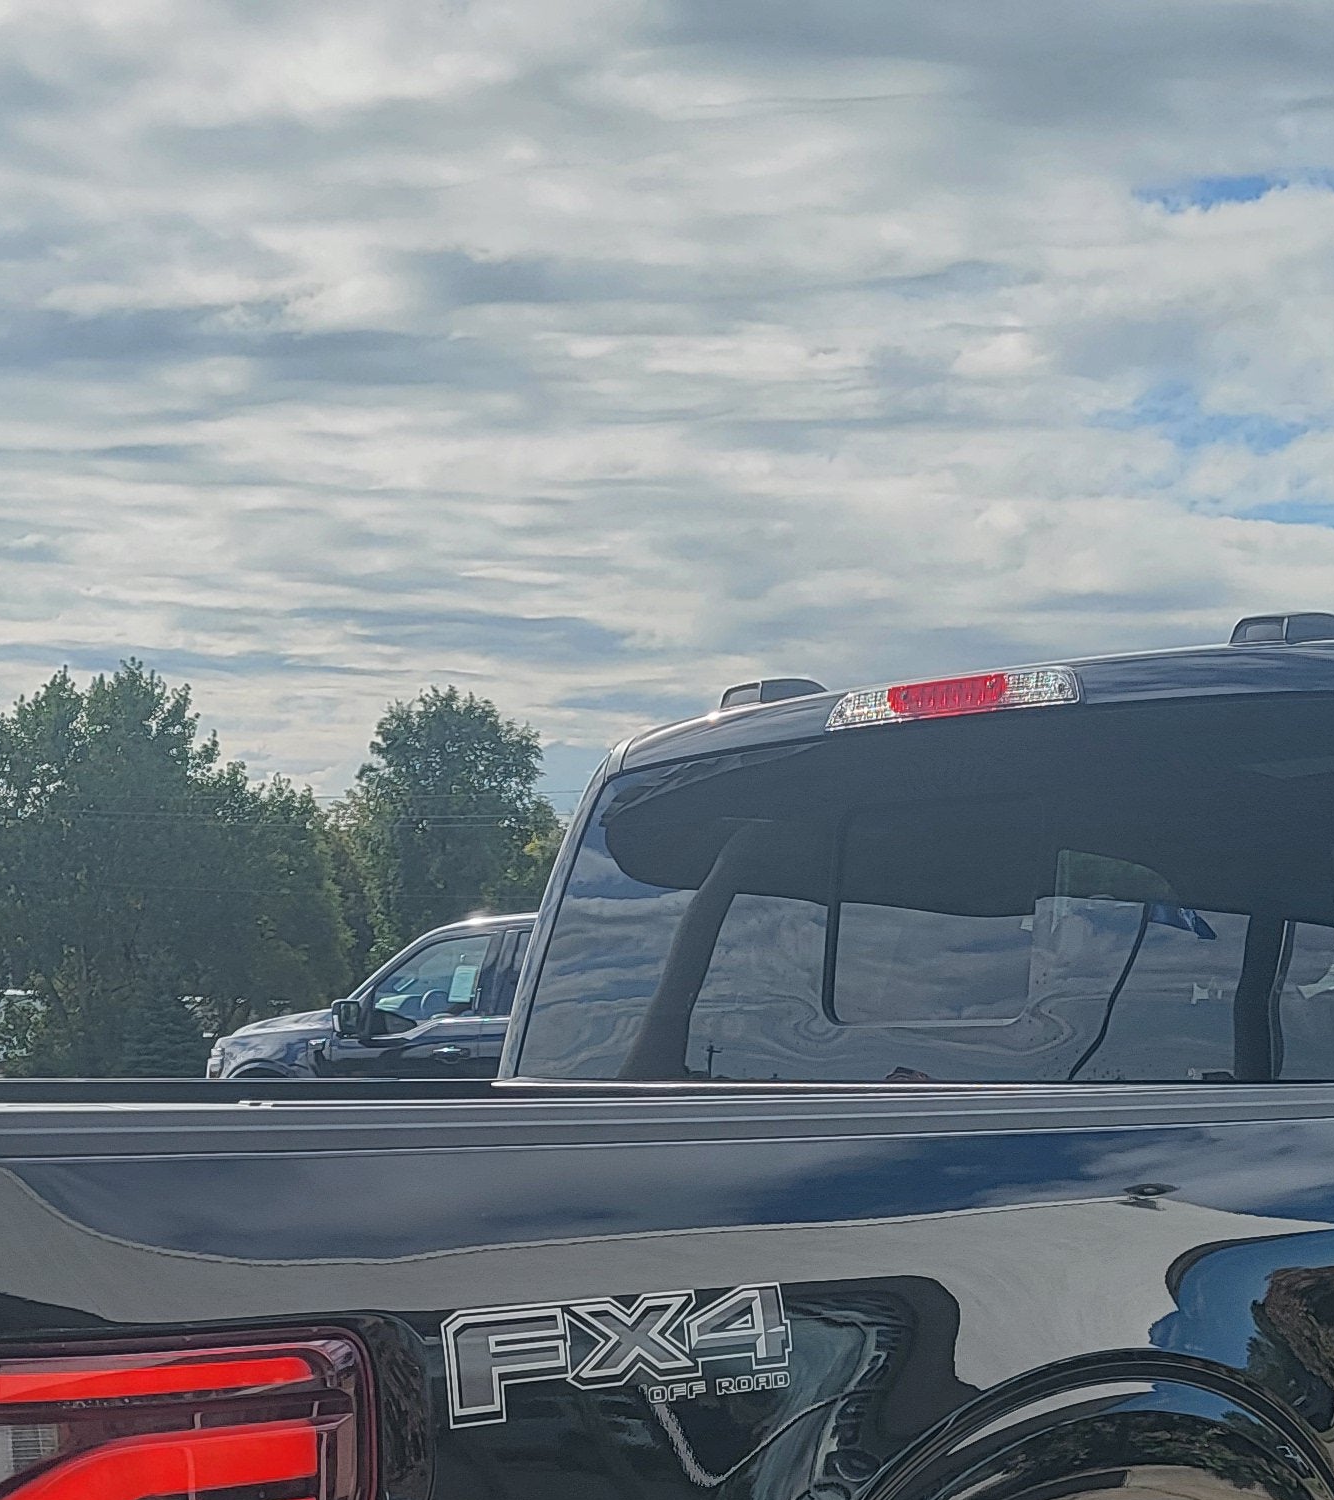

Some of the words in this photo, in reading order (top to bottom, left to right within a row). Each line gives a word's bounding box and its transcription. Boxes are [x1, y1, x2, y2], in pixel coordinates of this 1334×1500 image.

[441, 1282, 792, 1430] FX4
[648, 1381, 707, 1404] OFF
[716, 1371, 791, 1396] ROAD
